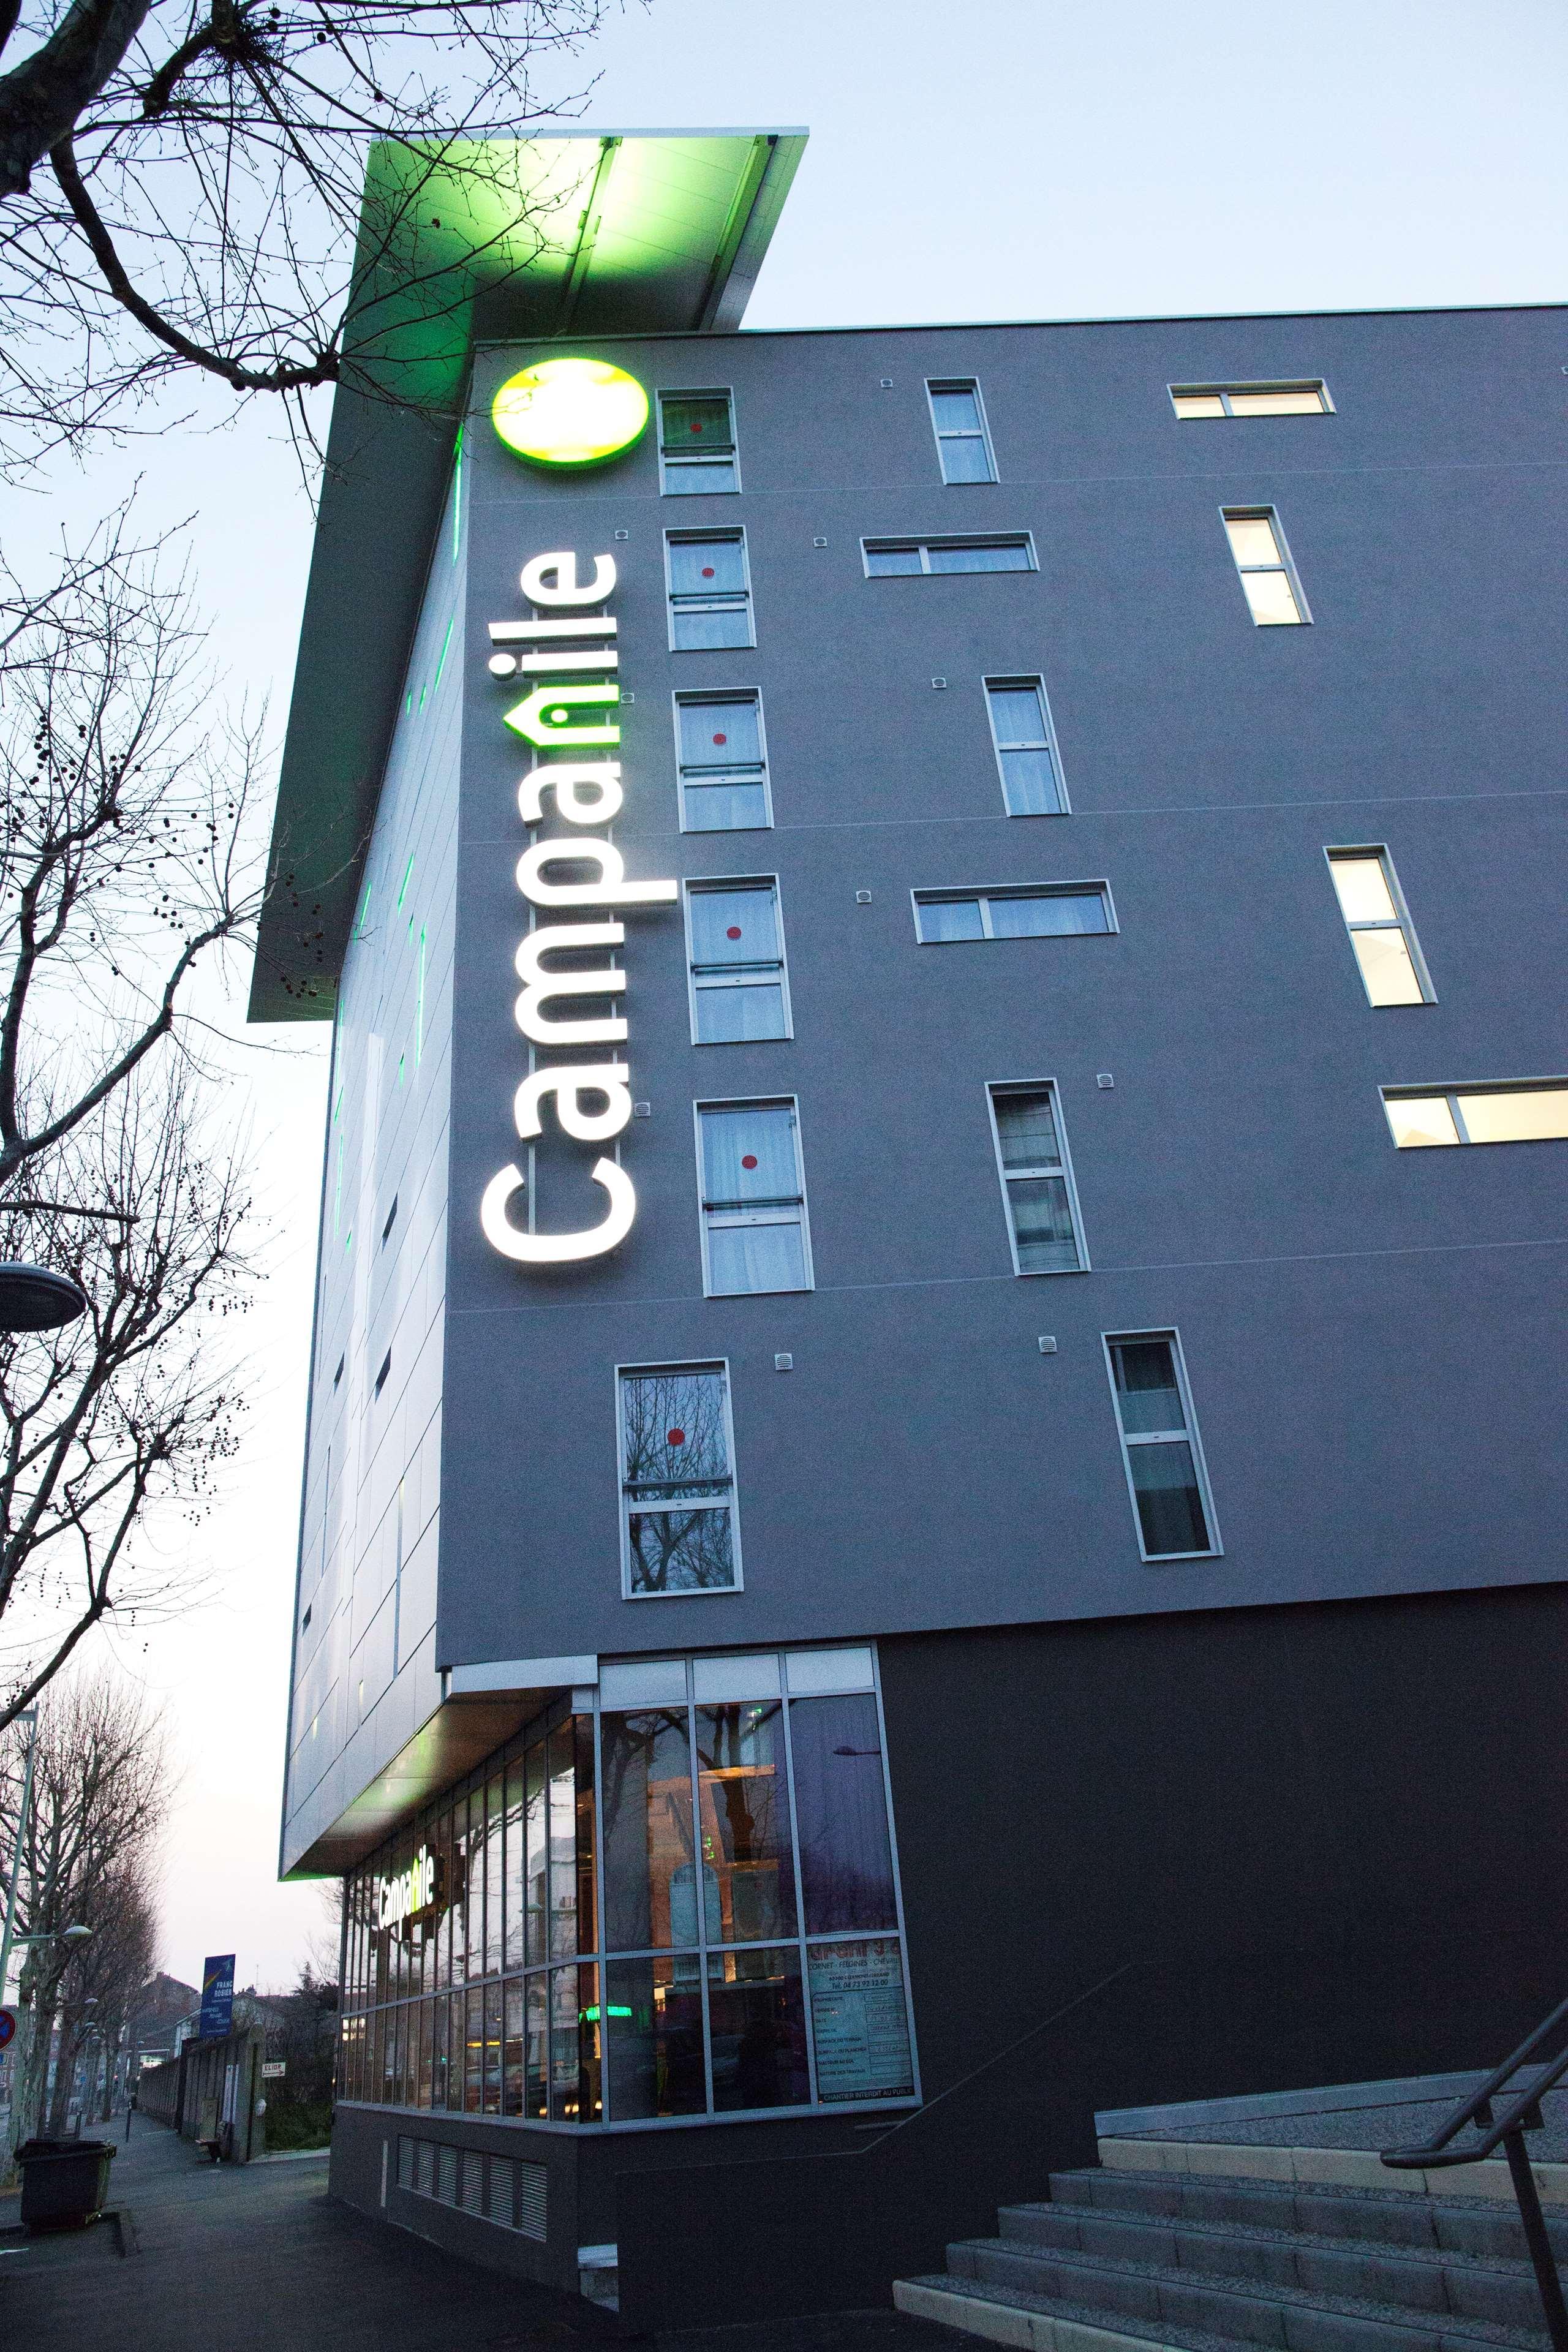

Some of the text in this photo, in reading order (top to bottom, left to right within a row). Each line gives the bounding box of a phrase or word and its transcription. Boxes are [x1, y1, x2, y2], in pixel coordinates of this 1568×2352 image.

[481, 551, 678, 1263] Campanile
[379, 1844, 434, 1942] Campanile
[216, 1980, 233, 1989] FRANC
[214, 1989, 232, 1998] ROSIER
[823, 2092, 854, 2101] CHANTIER
[855, 2090, 882, 2099] INTERDIT
